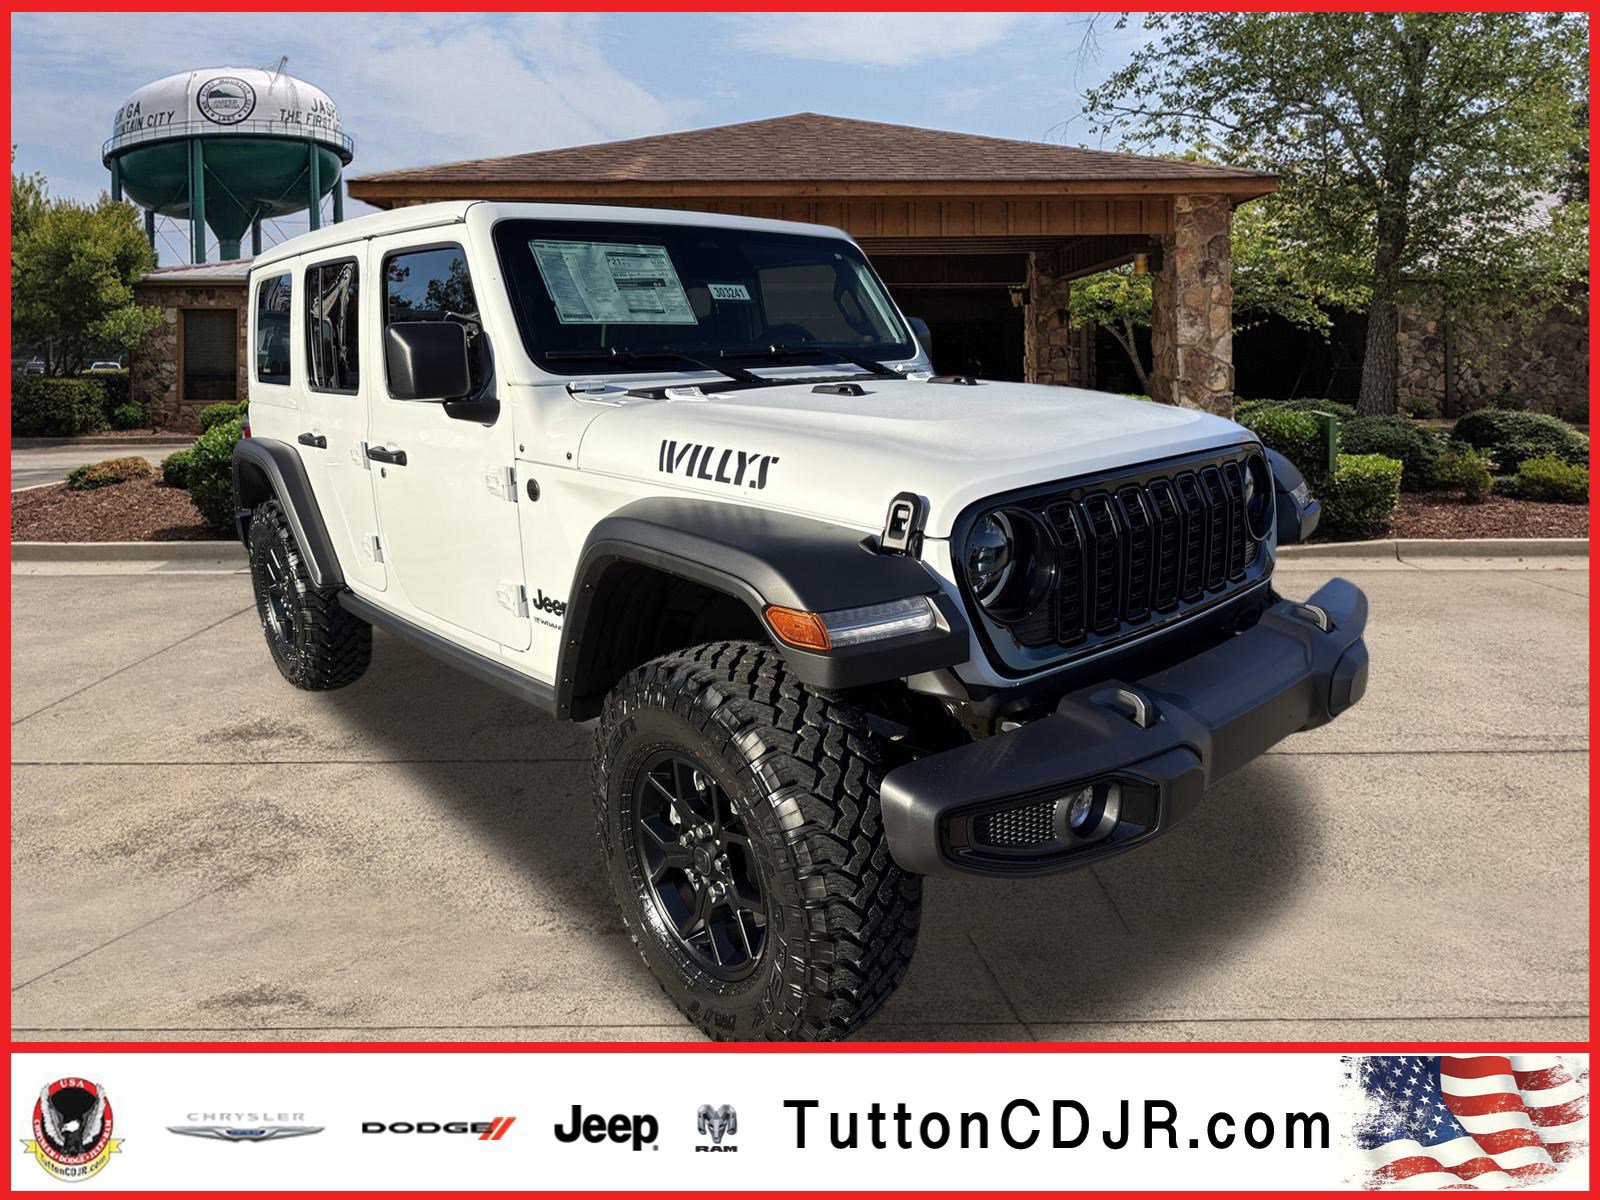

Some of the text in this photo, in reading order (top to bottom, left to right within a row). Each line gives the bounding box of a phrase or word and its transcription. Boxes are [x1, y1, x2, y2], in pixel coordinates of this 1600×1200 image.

[126, 101, 141, 119] GA
[147, 110, 176, 127] CITY
[280, 109, 302, 123] THE
[713, 287, 745, 298] 303241
[659, 439, 780, 491] WILLYS
